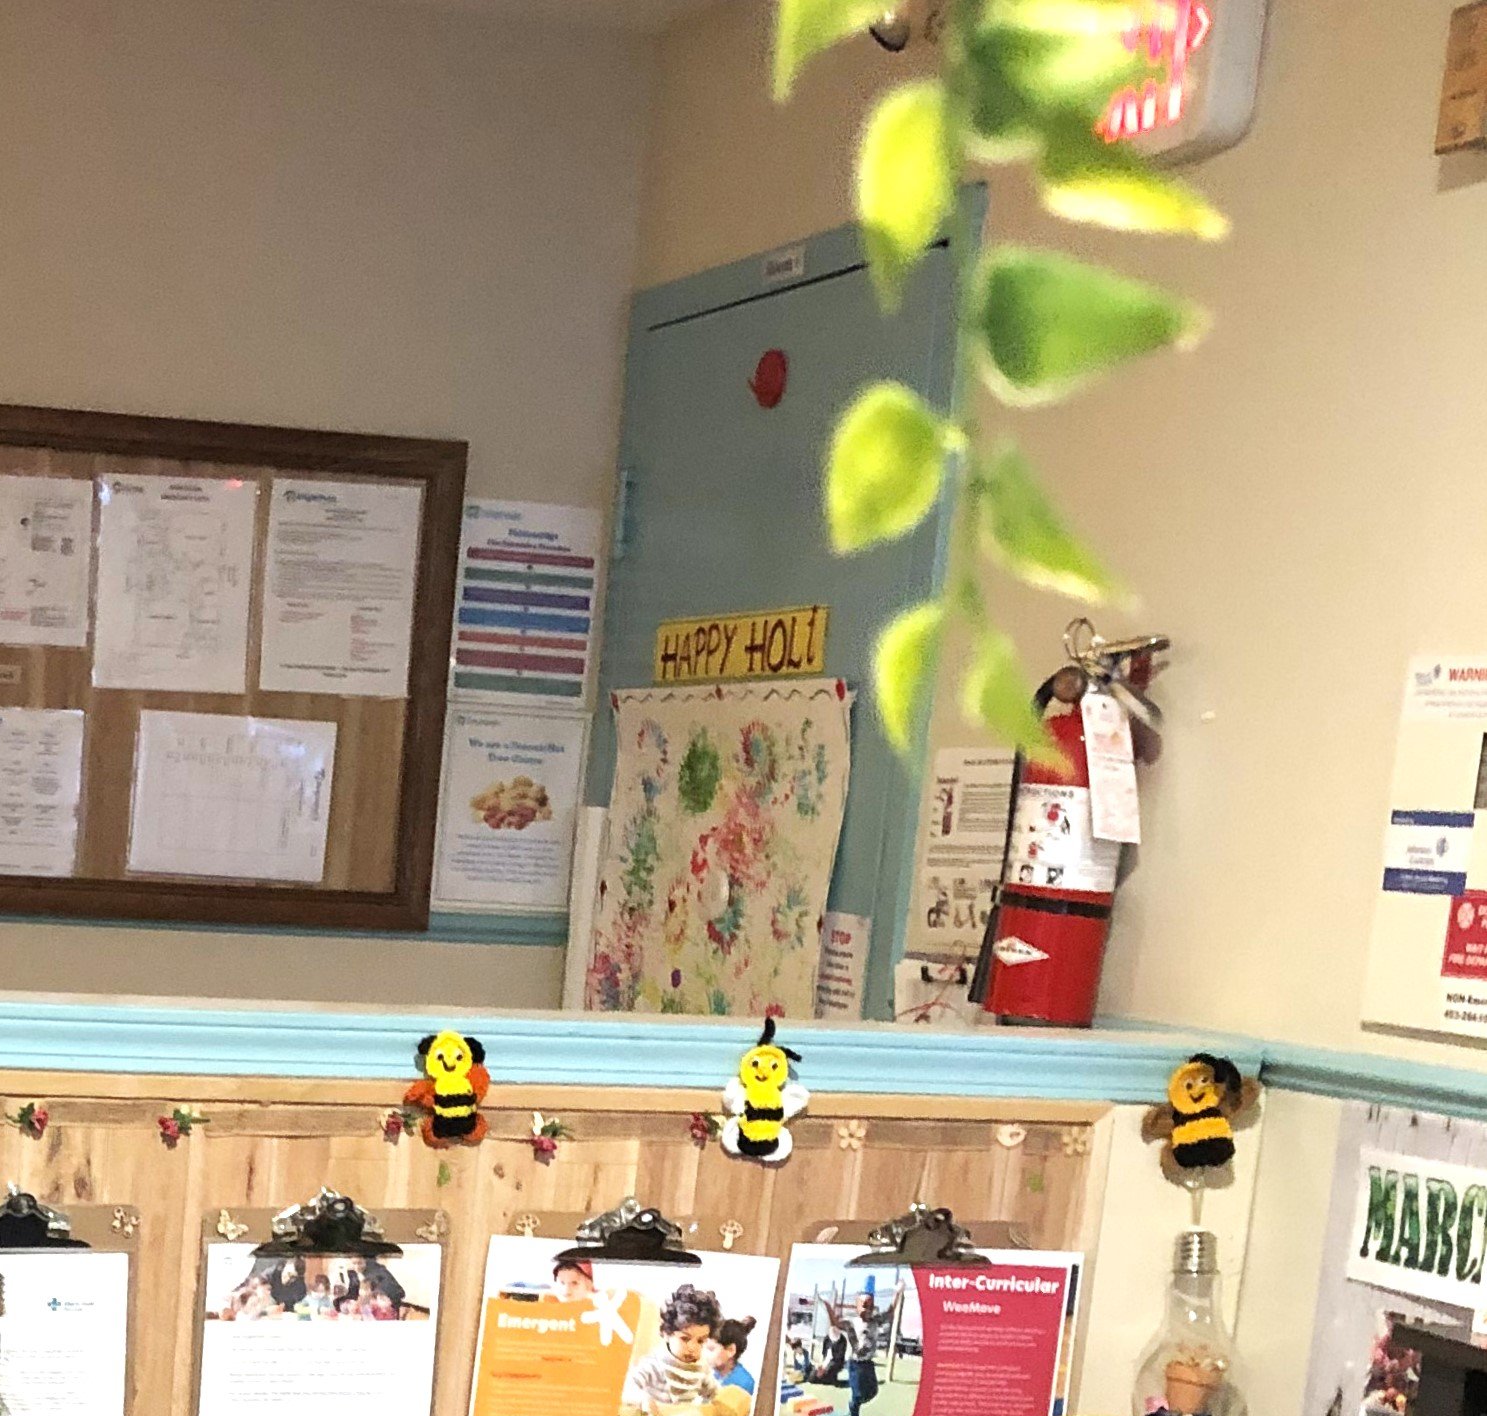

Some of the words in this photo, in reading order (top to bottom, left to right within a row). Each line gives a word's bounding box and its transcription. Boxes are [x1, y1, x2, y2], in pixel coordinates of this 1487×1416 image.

[661, 622, 738, 679] HAPPY
[745, 604, 818, 673] HOLI
[928, 1272, 1060, 1295] Inter-Curricular
[942, 1300, 1002, 1315] WeeMove
[497, 1313, 577, 1333] Emergent
